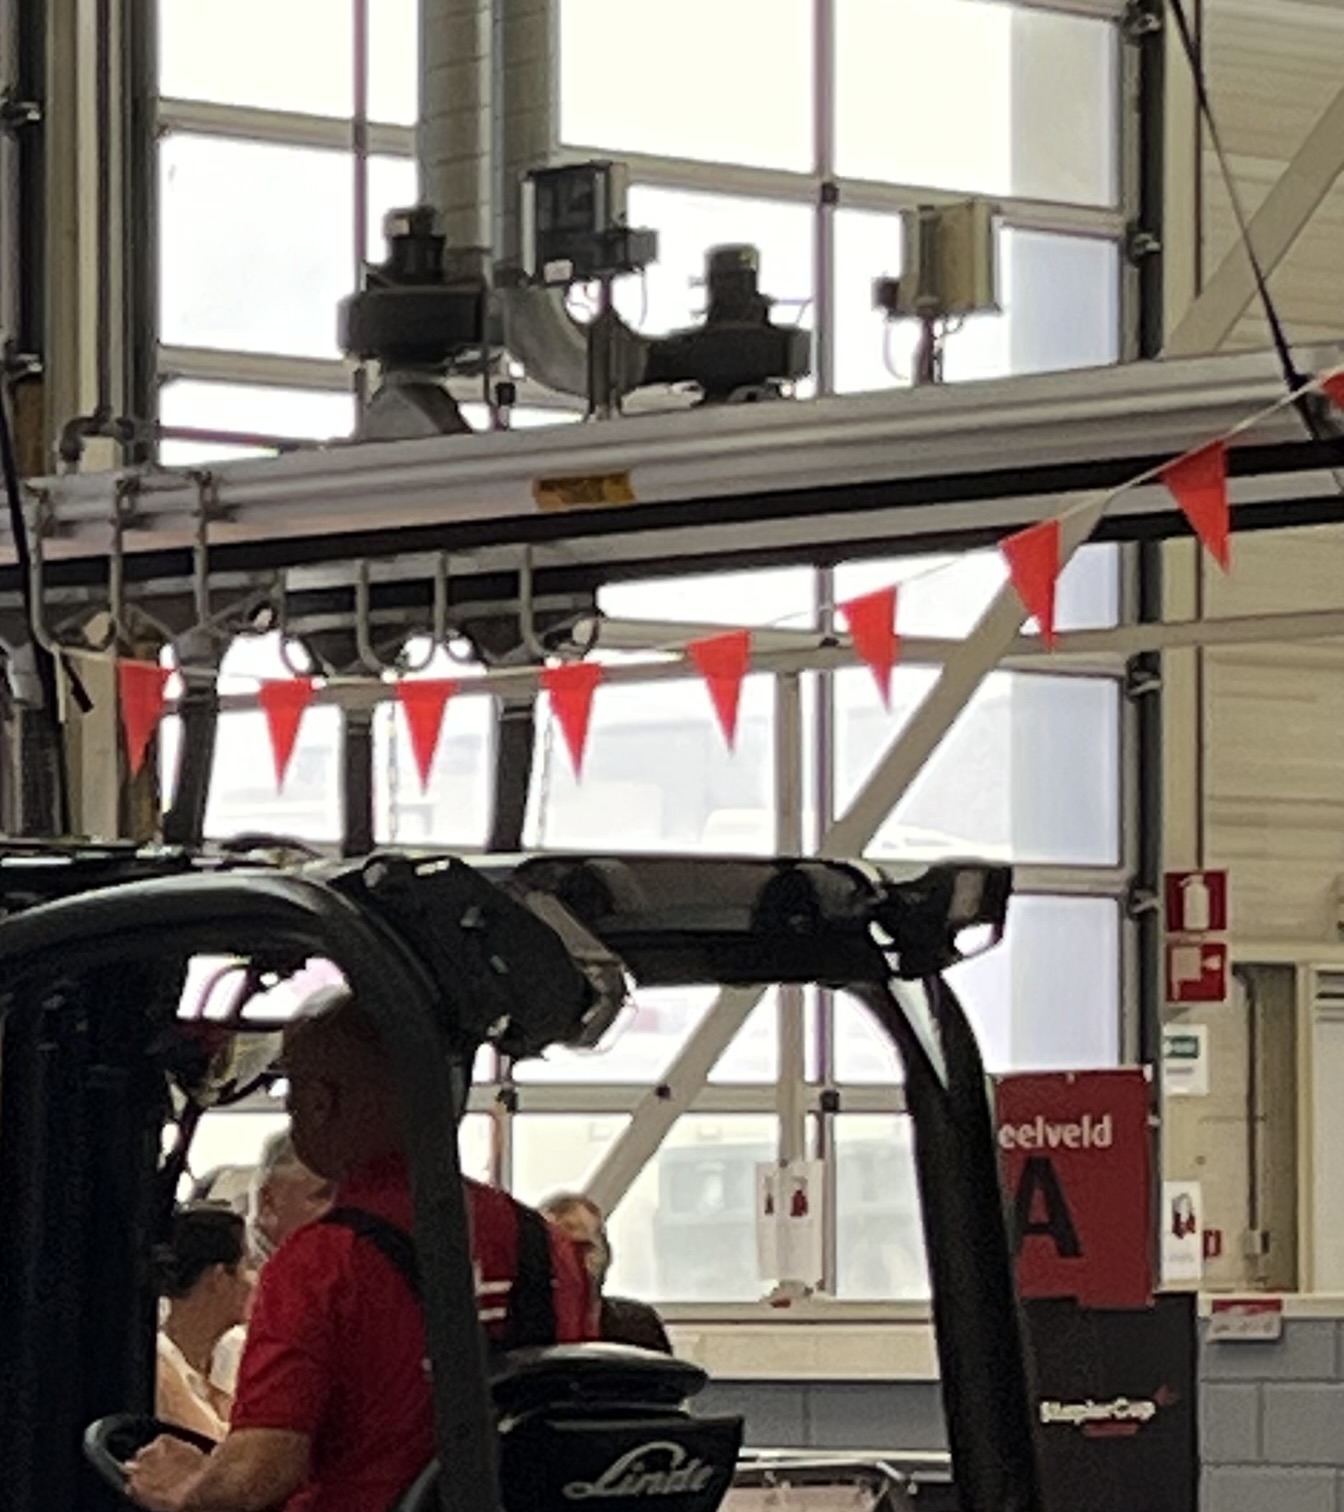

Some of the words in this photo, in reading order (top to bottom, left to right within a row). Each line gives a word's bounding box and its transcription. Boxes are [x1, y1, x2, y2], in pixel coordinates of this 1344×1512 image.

[998, 1115, 1112, 1148] eelveld
[1010, 1156, 1082, 1257] A
[563, 1440, 714, 1500] Linde
